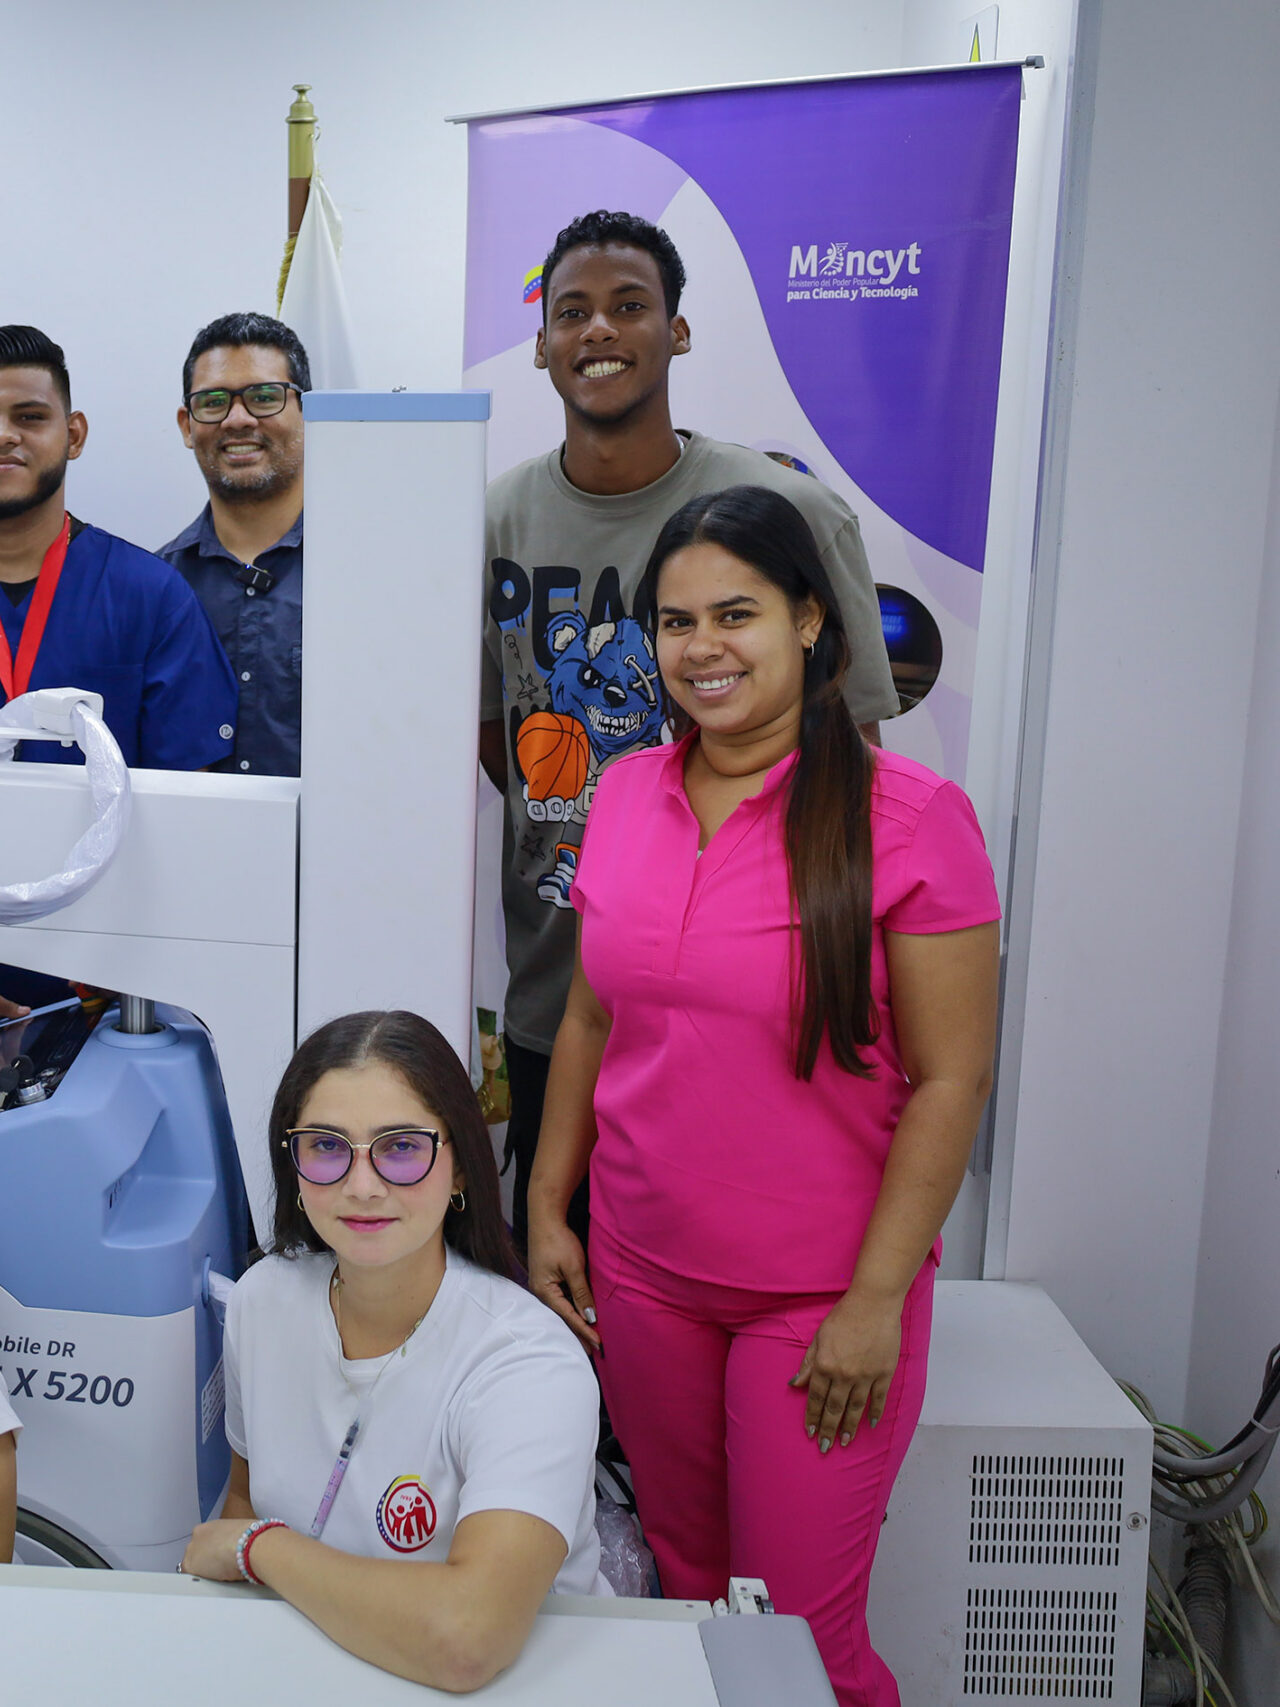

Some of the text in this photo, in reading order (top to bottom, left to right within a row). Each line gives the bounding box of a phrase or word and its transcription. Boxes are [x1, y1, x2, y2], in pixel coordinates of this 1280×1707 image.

[787, 277, 880, 288] Ministerio del Poder Popular
[787, 284, 919, 302] para Ciencia y Tecnología
[46, 1340, 76, 1358] DR
[43, 1370, 135, 1407] 5200
